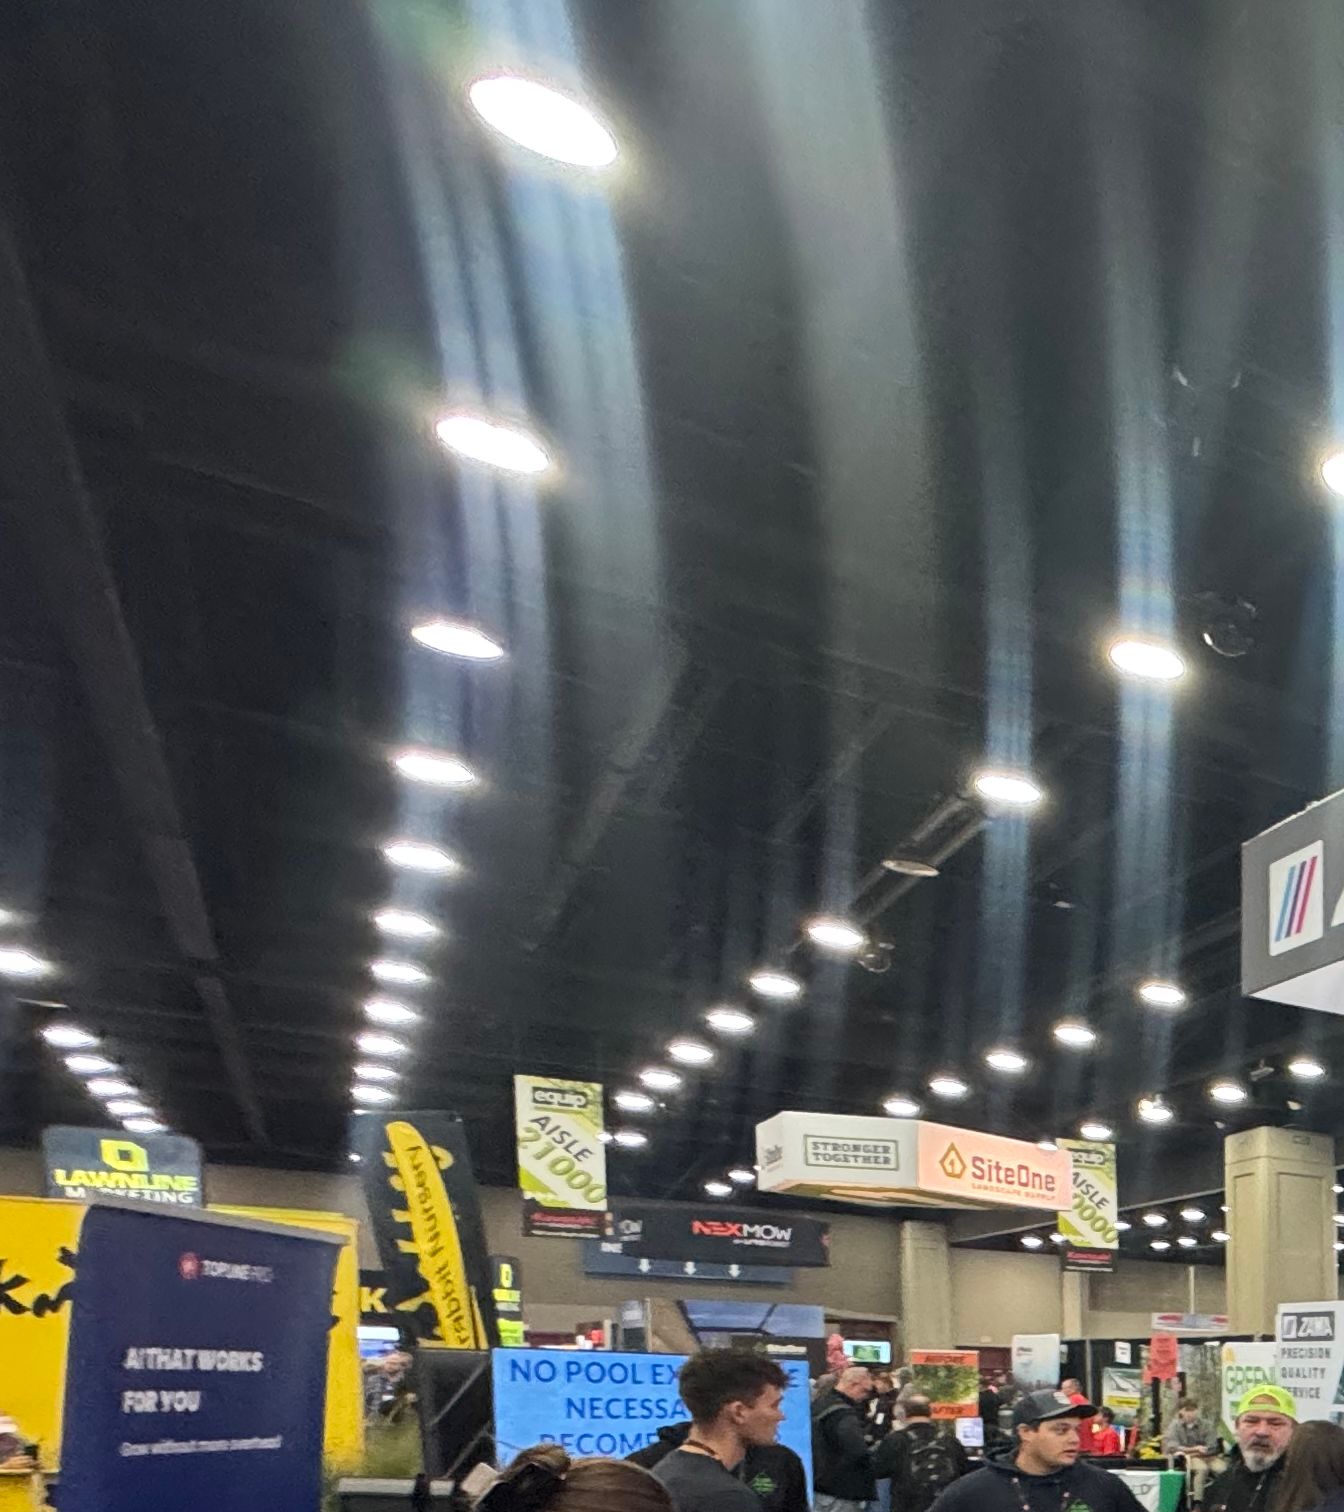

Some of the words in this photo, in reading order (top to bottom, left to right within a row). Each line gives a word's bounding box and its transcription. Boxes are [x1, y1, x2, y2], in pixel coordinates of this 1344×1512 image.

[533, 1089, 587, 1107] equip
[530, 1116, 594, 1162] AISLE
[811, 1141, 891, 1155] STRONGER
[812, 1152, 892, 1165] TOGETHER
[971, 1156, 1056, 1192] SiteOne
[691, 1219, 792, 1241] NEXMOW
[143, 1347, 196, 1370] THAT
[197, 1349, 264, 1372] WORKS
[1281, 1346, 1332, 1360] PRECISION
[510, 1359, 555, 1382] NO
[566, 1361, 644, 1385] POOL
[1281, 1367, 1326, 1379] QUALITY
[122, 1390, 158, 1414] FOR
[159, 1390, 201, 1413] YOU
[1283, 1386, 1321, 1399] ERVICE
